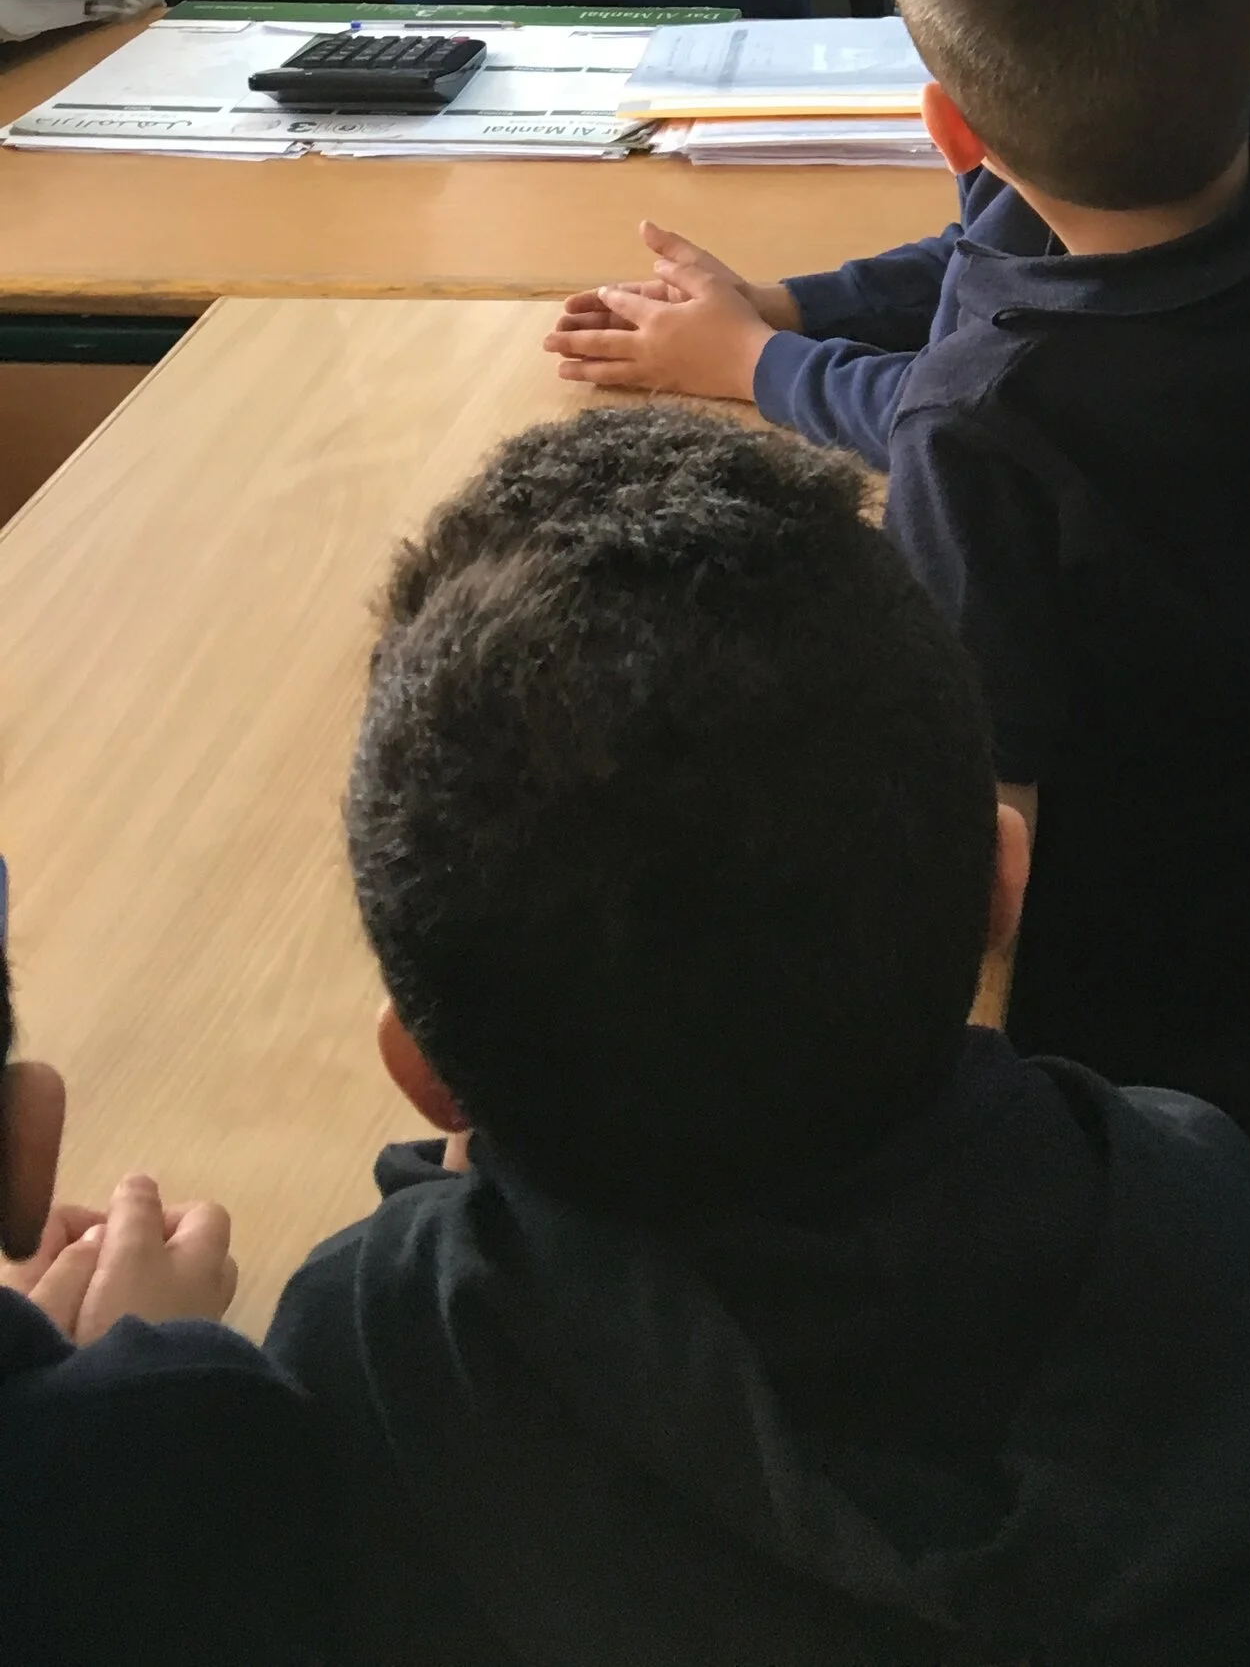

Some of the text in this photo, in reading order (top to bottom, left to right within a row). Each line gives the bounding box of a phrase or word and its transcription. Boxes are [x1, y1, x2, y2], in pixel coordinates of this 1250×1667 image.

[578, 10, 720, 22] Dar Al Manhal
[35, 117, 193, 131] دار المنهل
[480, 125, 567, 137] Manhal
[571, 127, 597, 138] Al
